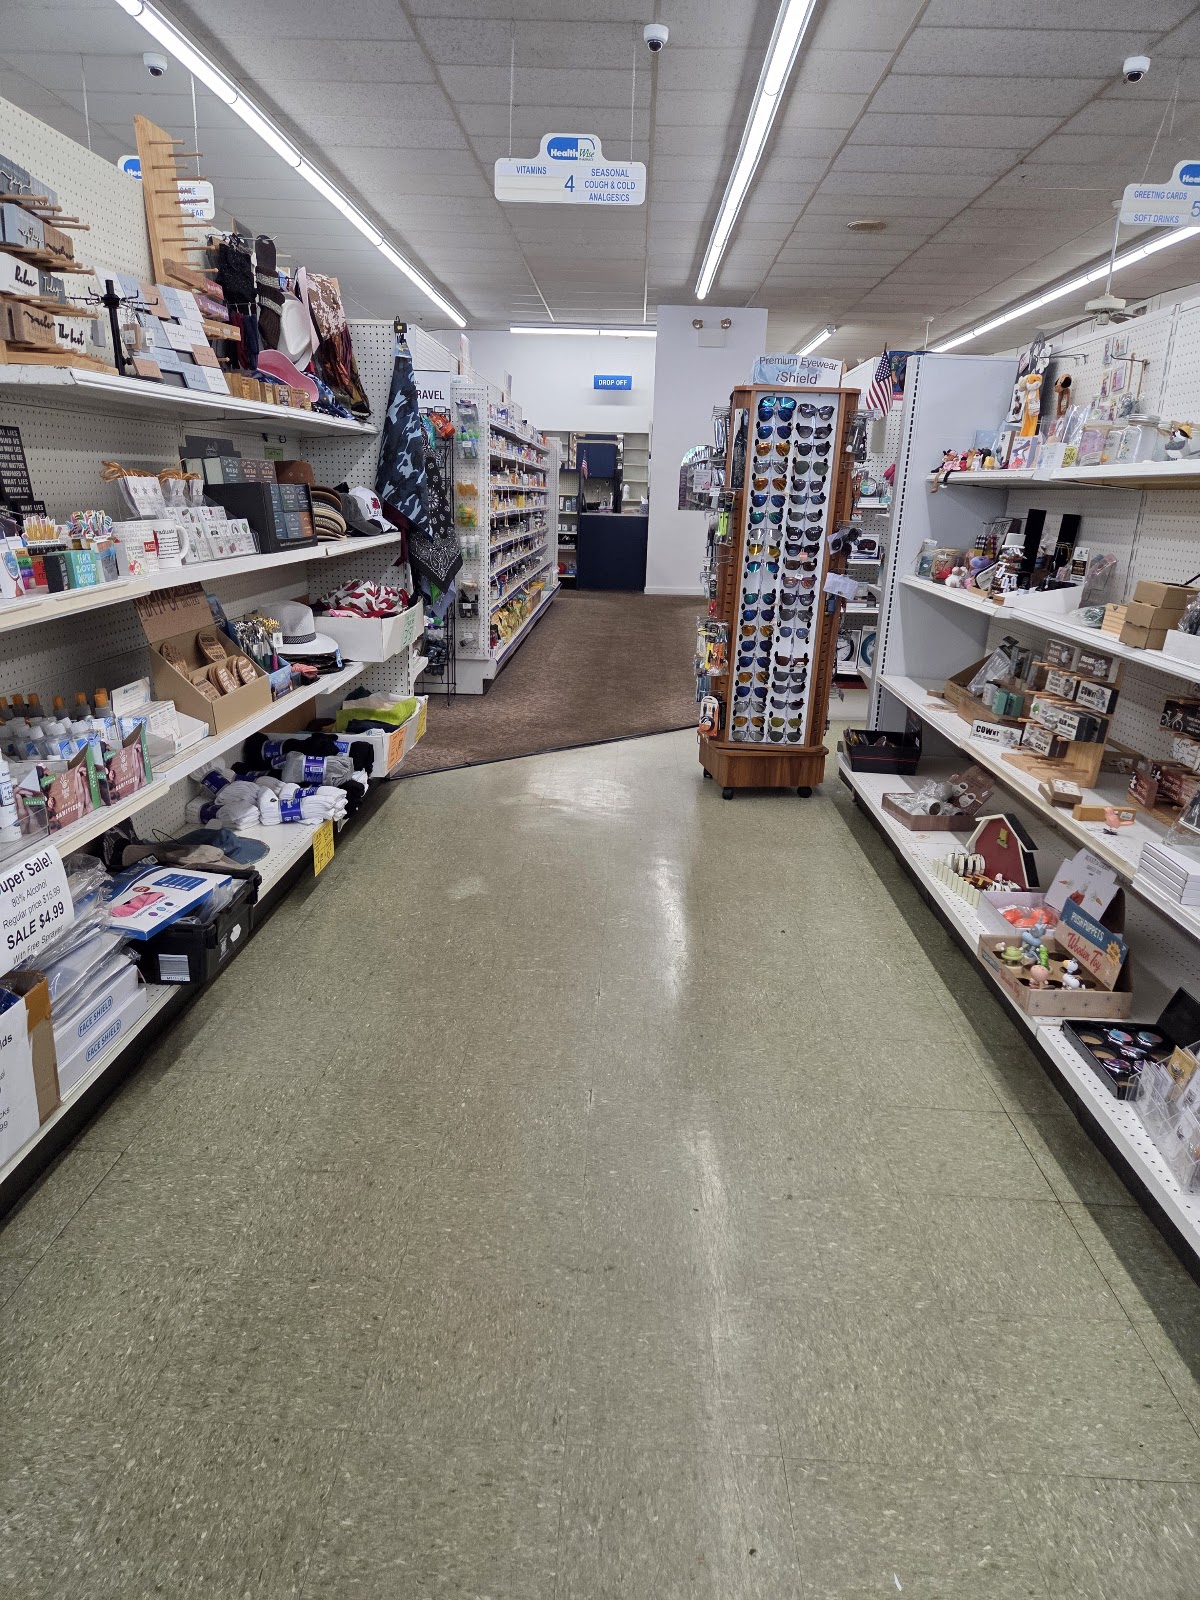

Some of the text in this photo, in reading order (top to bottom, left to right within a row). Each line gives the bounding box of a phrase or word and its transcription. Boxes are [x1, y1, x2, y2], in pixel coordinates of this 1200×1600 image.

[550, 148, 578, 157] Health
[516, 166, 547, 175] VITAMINS
[591, 168, 630, 178] SEASONAL
[564, 174, 575, 192] 4
[584, 180, 636, 190] COUGH & COLD
[588, 193, 630, 202] ANALGESICS
[1134, 190, 1188, 200] GREETING CARDS
[1191, 200, 1200, 218] 5
[1134, 214, 1180, 224] SOFT DRINKS
[760, 356, 838, 370] Premium Eyewear
[776, 371, 818, 384] iShield
[76, 564, 96, 572] LOVE
[56, 802, 82, 820] SANITIZER
[24, 852, 53, 876] Sale!
[12, 879, 48, 908] 80% Alcohol
[2, 885, 61, 930] Regular price $15.99
[6, 901, 64, 950] SALE $4.99
[1071, 911, 1105, 942] PUSH PUPPETS
[26, 940, 40, 954] Free
[41, 924, 64, 945] Sprayer
[1068, 932, 1090, 963] Wooden
[1089, 950, 1104, 974] Toy
[79, 998, 112, 1034] FACE SHIELD
[87, 1022, 121, 1058] FACE SHIELD
